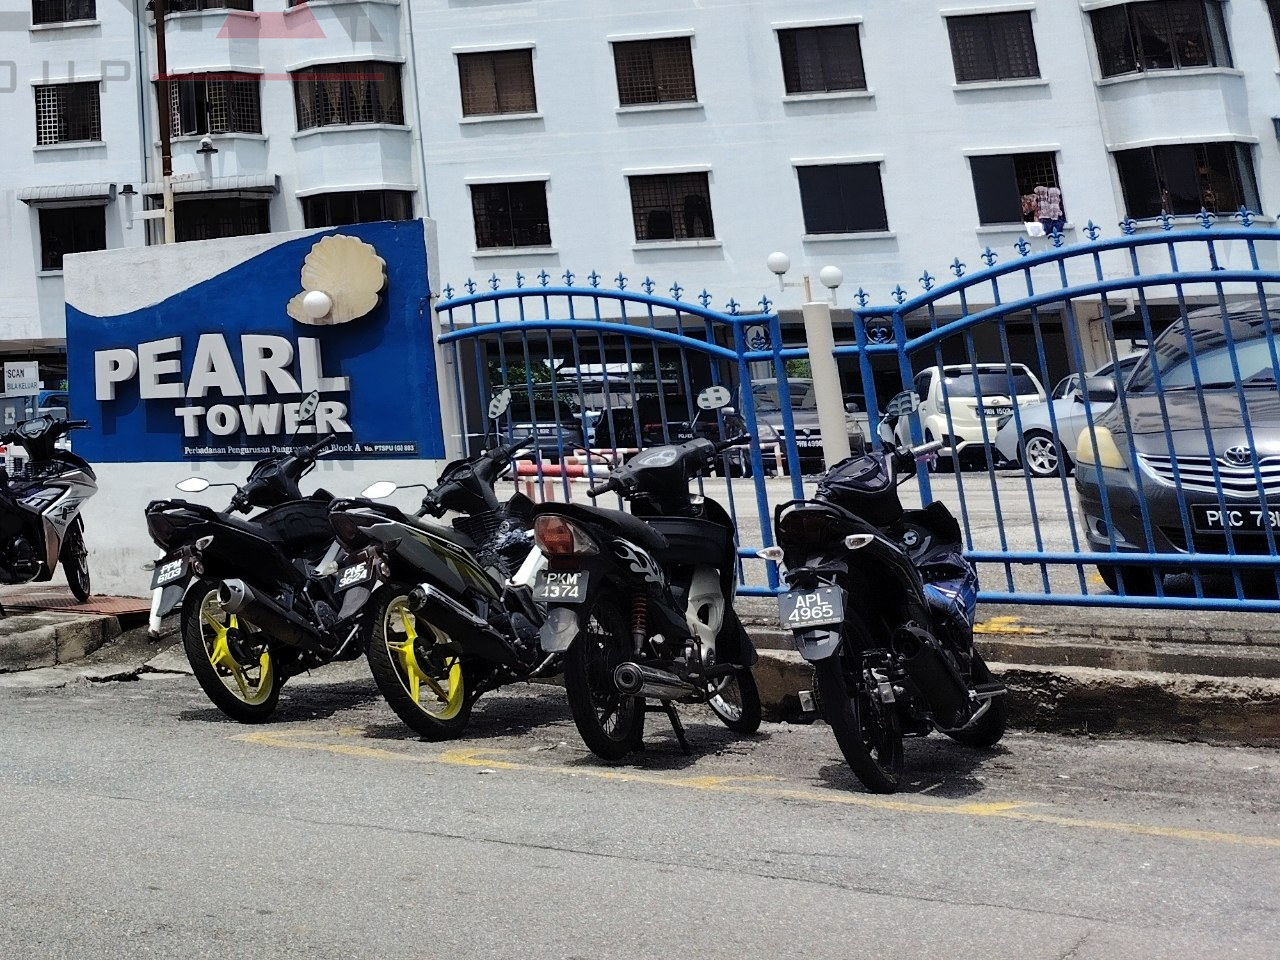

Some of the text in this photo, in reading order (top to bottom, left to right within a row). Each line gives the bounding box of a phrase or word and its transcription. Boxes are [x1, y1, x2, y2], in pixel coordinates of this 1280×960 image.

[7, 368, 24, 379] SCAN
[94, 333, 350, 401] PEARL
[19, 382, 38, 390] KELUAR
[174, 401, 353, 437] TOWER
[184, 446, 226, 454] Perbadanan
[227, 445, 271, 455] Pengurusan
[331, 443, 354, 452] Block
[354, 443, 361, 452] A
[546, 572, 578, 585] PKM
[795, 592, 829, 609] APL
[788, 604, 834, 621] 4965
